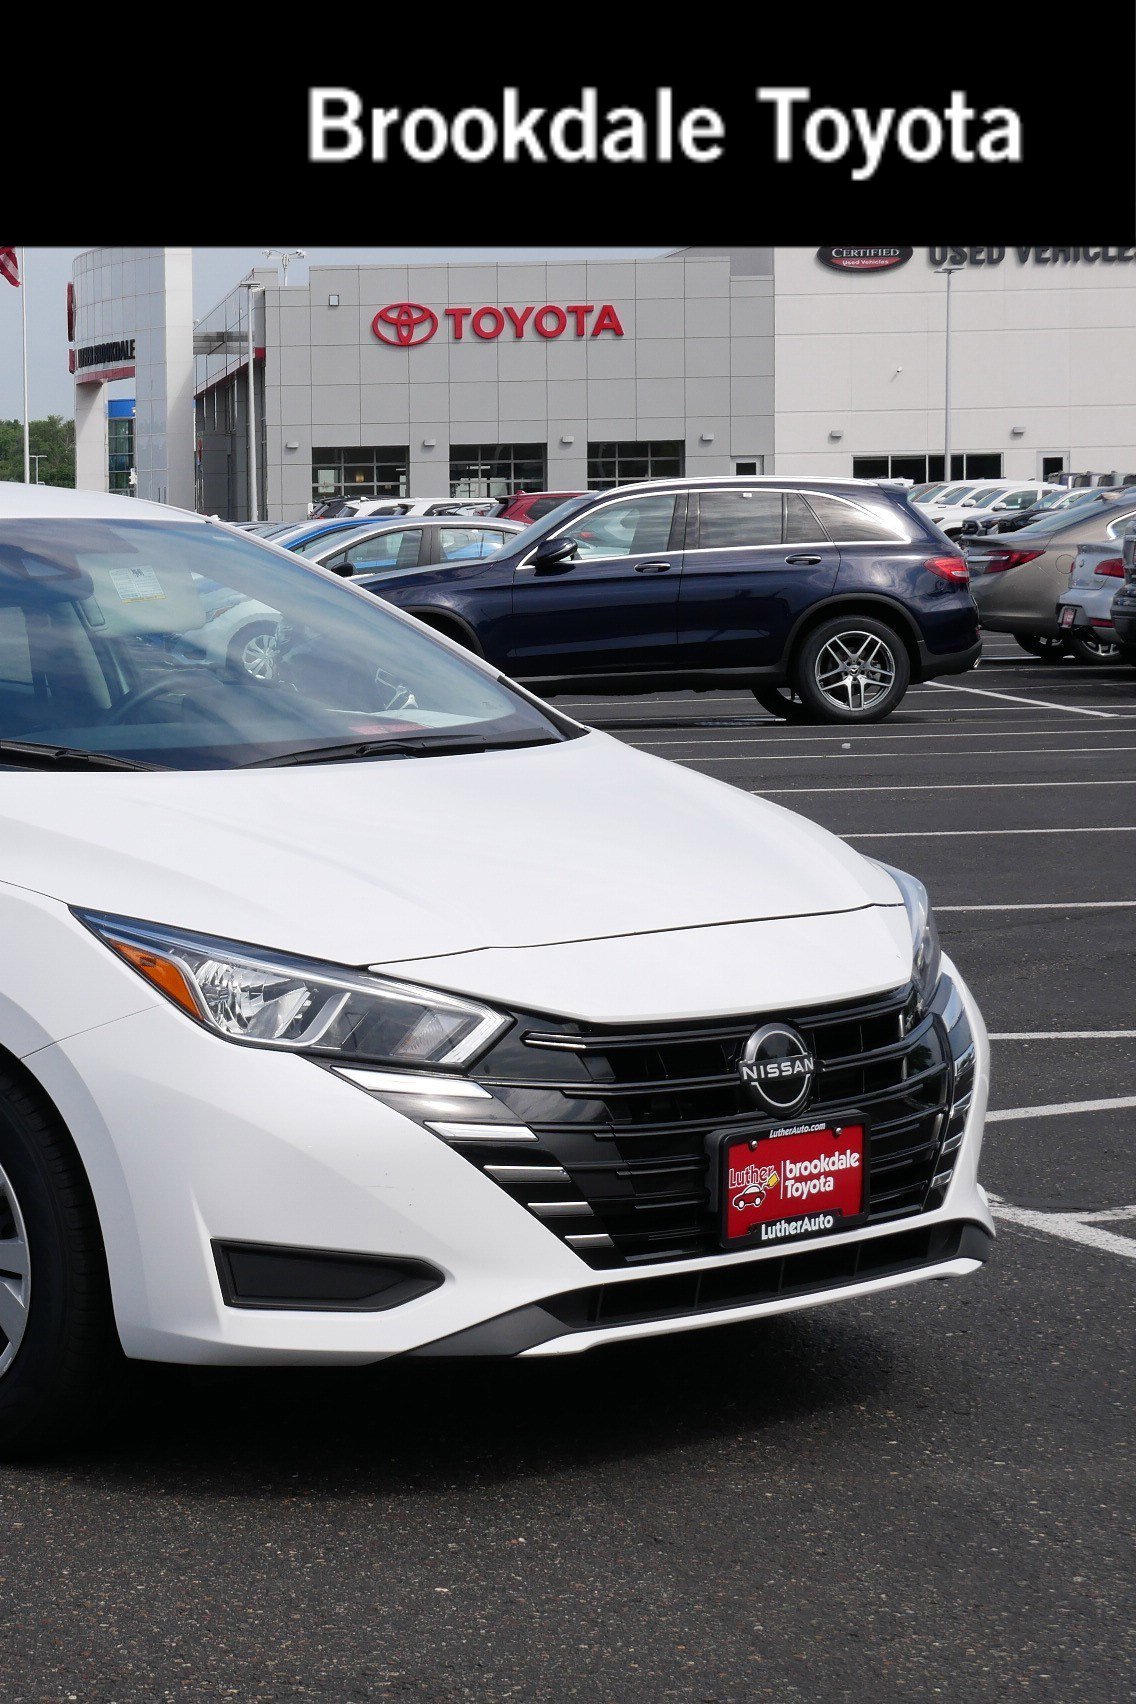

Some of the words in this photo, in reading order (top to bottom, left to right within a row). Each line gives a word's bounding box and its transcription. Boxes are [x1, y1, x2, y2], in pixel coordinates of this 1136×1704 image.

[831, 248, 900, 258] CERTIFIED
[927, 246, 1006, 265] USED
[1015, 246, 1136, 263] VEHICLE
[444, 304, 625, 340] TOYOTA
[742, 1057, 814, 1080] NISSAN
[769, 1123, 826, 1139] LutherAuto.com
[728, 1164, 775, 1189] Luther
[785, 1149, 860, 1179] brookdale
[785, 1175, 834, 1200] Toyota
[761, 1214, 834, 1241] LutherAuto
